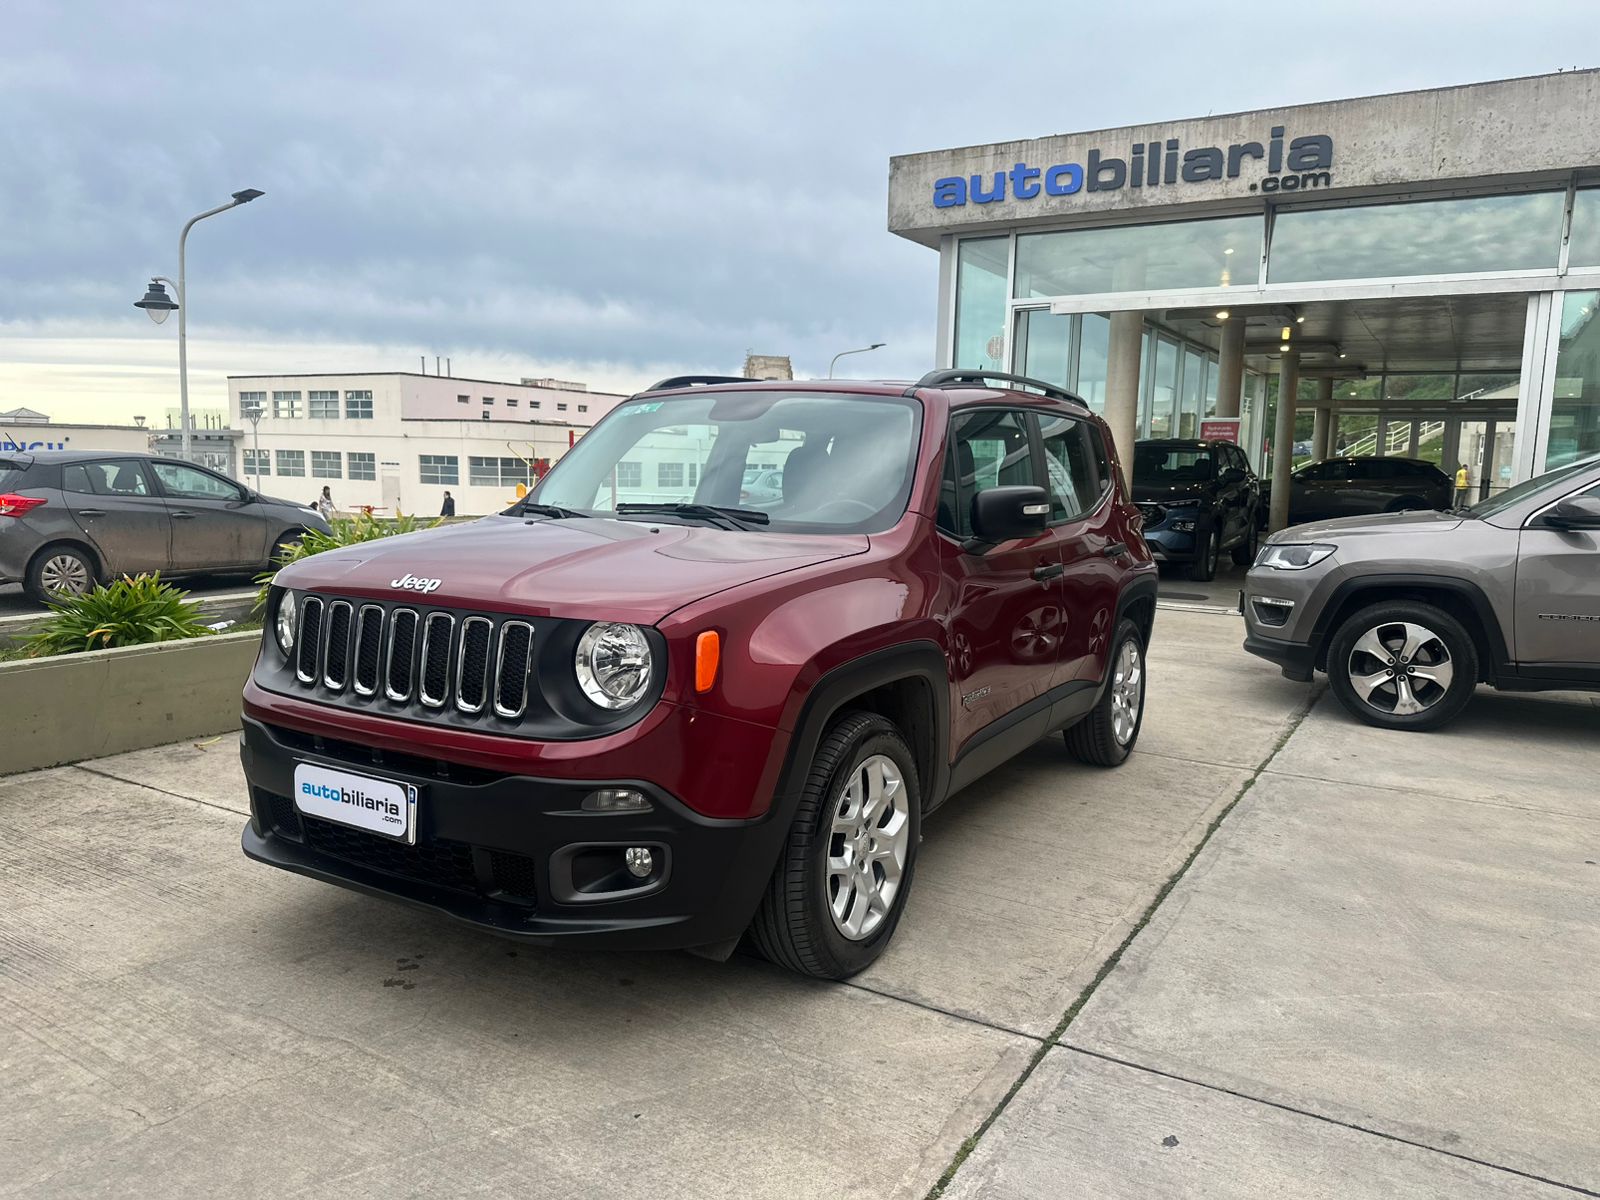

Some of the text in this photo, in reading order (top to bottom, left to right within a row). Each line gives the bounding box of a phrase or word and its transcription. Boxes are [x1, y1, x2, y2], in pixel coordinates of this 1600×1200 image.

[933, 126, 1334, 208] autobiliaria
[1249, 171, 1331, 193] .com
[391, 573, 442, 595] Jeep
[302, 782, 400, 816] autobiliaria
[381, 815, 403, 825] .com
